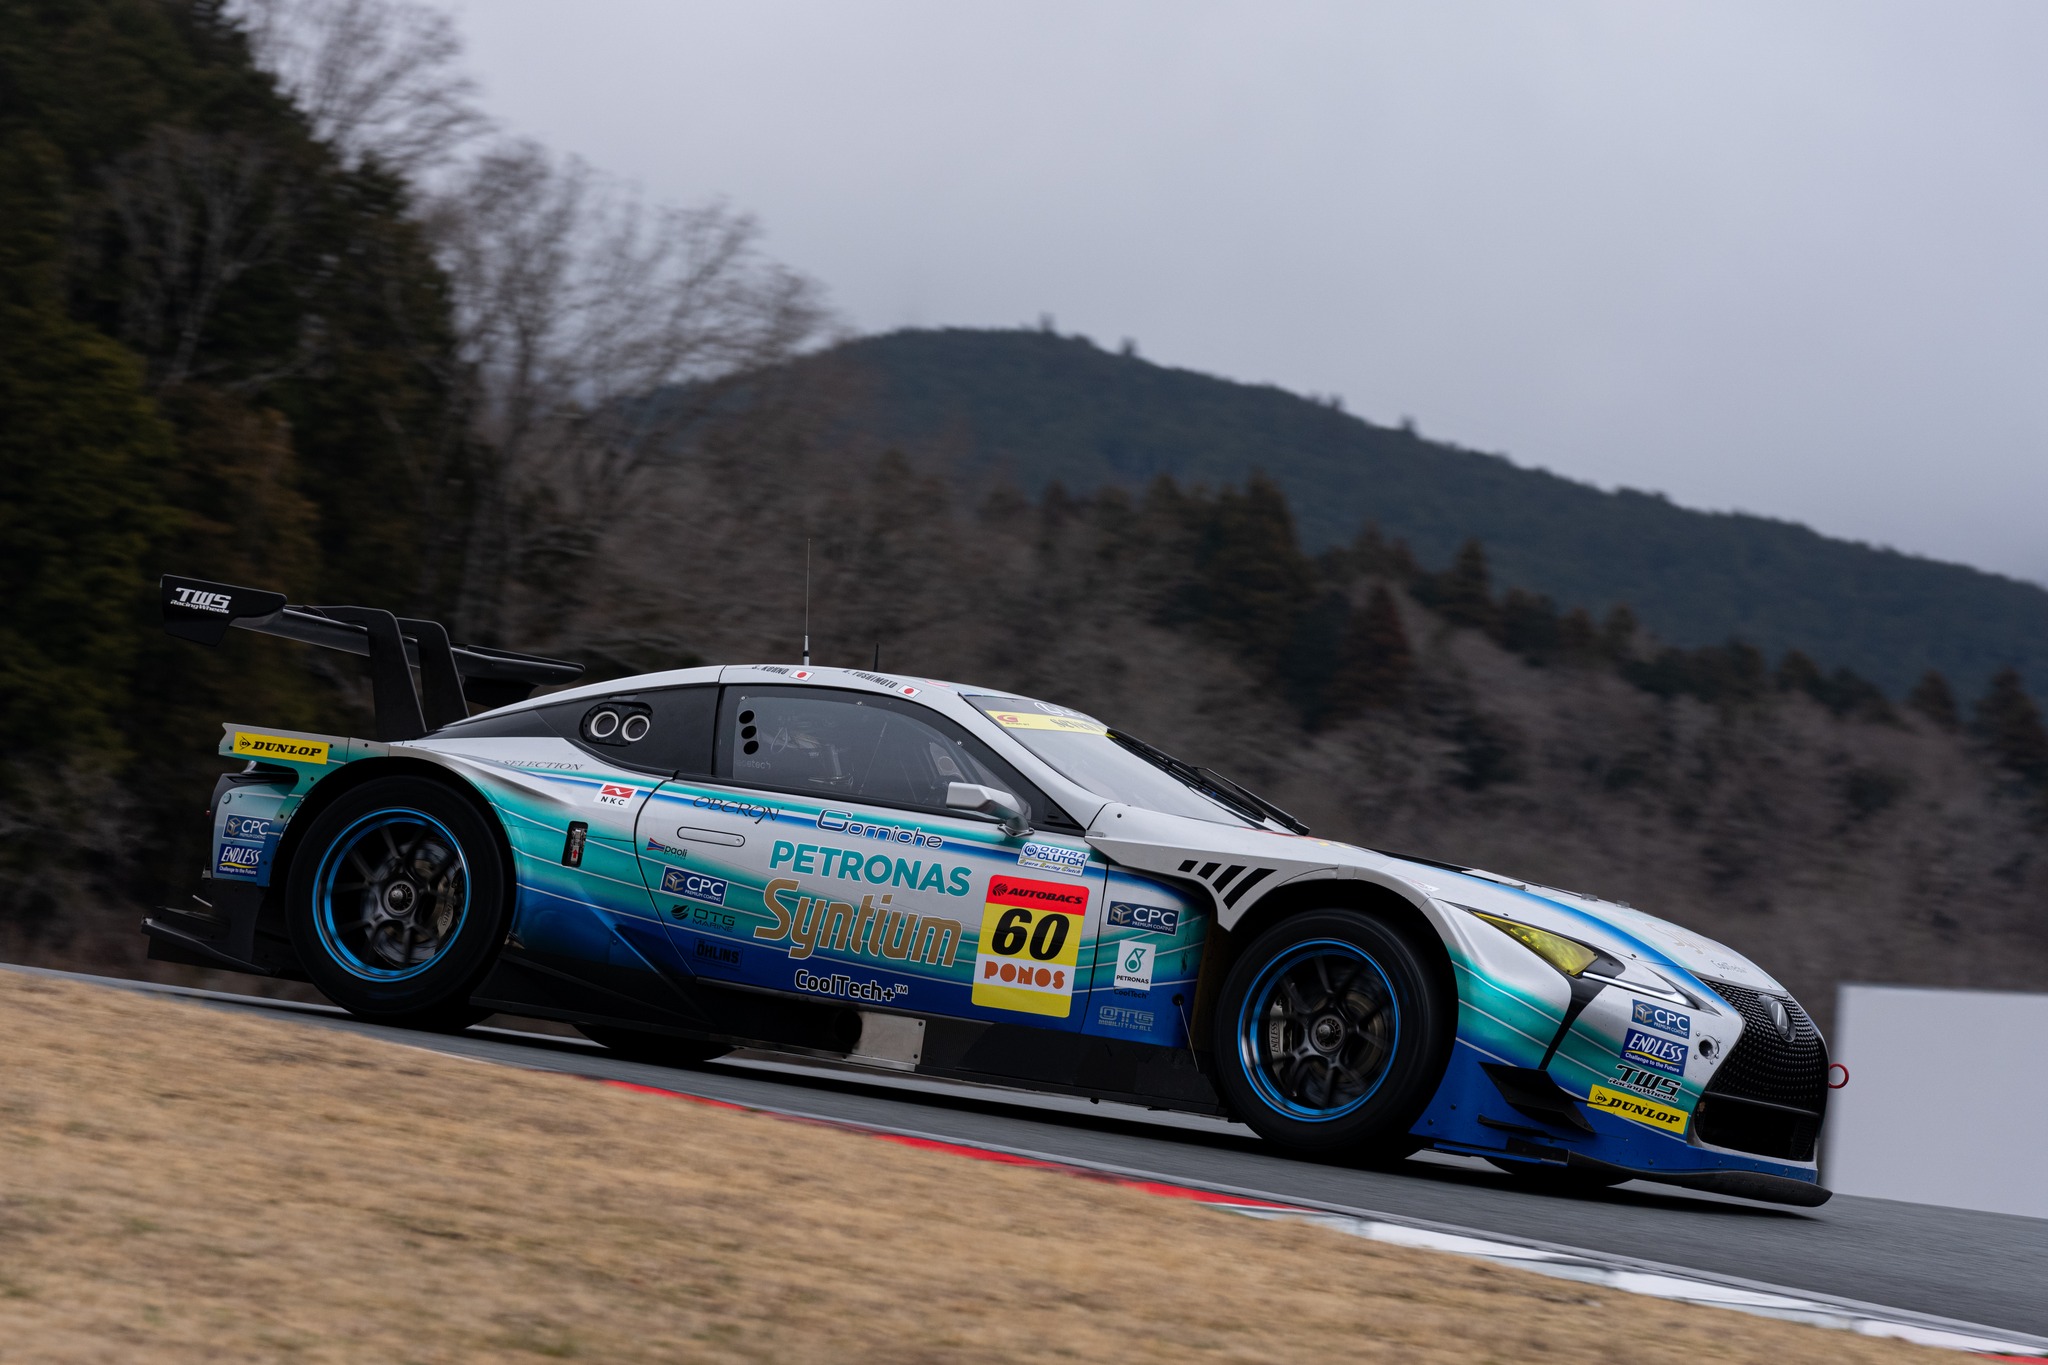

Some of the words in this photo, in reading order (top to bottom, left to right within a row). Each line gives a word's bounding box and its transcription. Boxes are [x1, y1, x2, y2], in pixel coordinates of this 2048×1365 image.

[175, 587, 232, 609] TWS
[252, 741, 322, 756] DUNLOP
[503, 760, 584, 771] SELECTION
[600, 795, 626, 806] NKC
[692, 796, 781, 825] OBERON
[241, 819, 270, 835] CPC
[221, 846, 263, 865] ENDLESS
[664, 845, 688, 858] paoli
[1037, 852, 1085, 867] CLUTCH
[1039, 846, 1086, 860] OGURA
[768, 840, 972, 897] PETRONAS
[686, 876, 724, 897] CPC
[1008, 887, 1084, 905] AUTOBACS
[693, 918, 734, 932] MARINE
[694, 908, 735, 926] OTG
[753, 878, 963, 968] Syntium
[1132, 921, 1153, 929] PREMIUM
[1153, 924, 1174, 932] COATING
[1133, 907, 1176, 927] CPC
[991, 908, 1070, 961] 60
[697, 942, 739, 964] ÖHLINS
[984, 960, 1066, 990] PONOS
[1116, 975, 1150, 985] PETRONAS
[1653, 1022, 1671, 1032] PREMIUM
[1671, 1027, 1688, 1037] COATING
[1654, 1009, 1688, 1031] CPC
[1628, 1033, 1685, 1062] ENDLESS
[1625, 1052, 1649, 1064] Challenge
[1655, 1061, 1664, 1069] the
[1664, 1064, 1680, 1073] Future
[1616, 1064, 1682, 1096] TWS
[1607, 1097, 1680, 1124] DUNLOP
